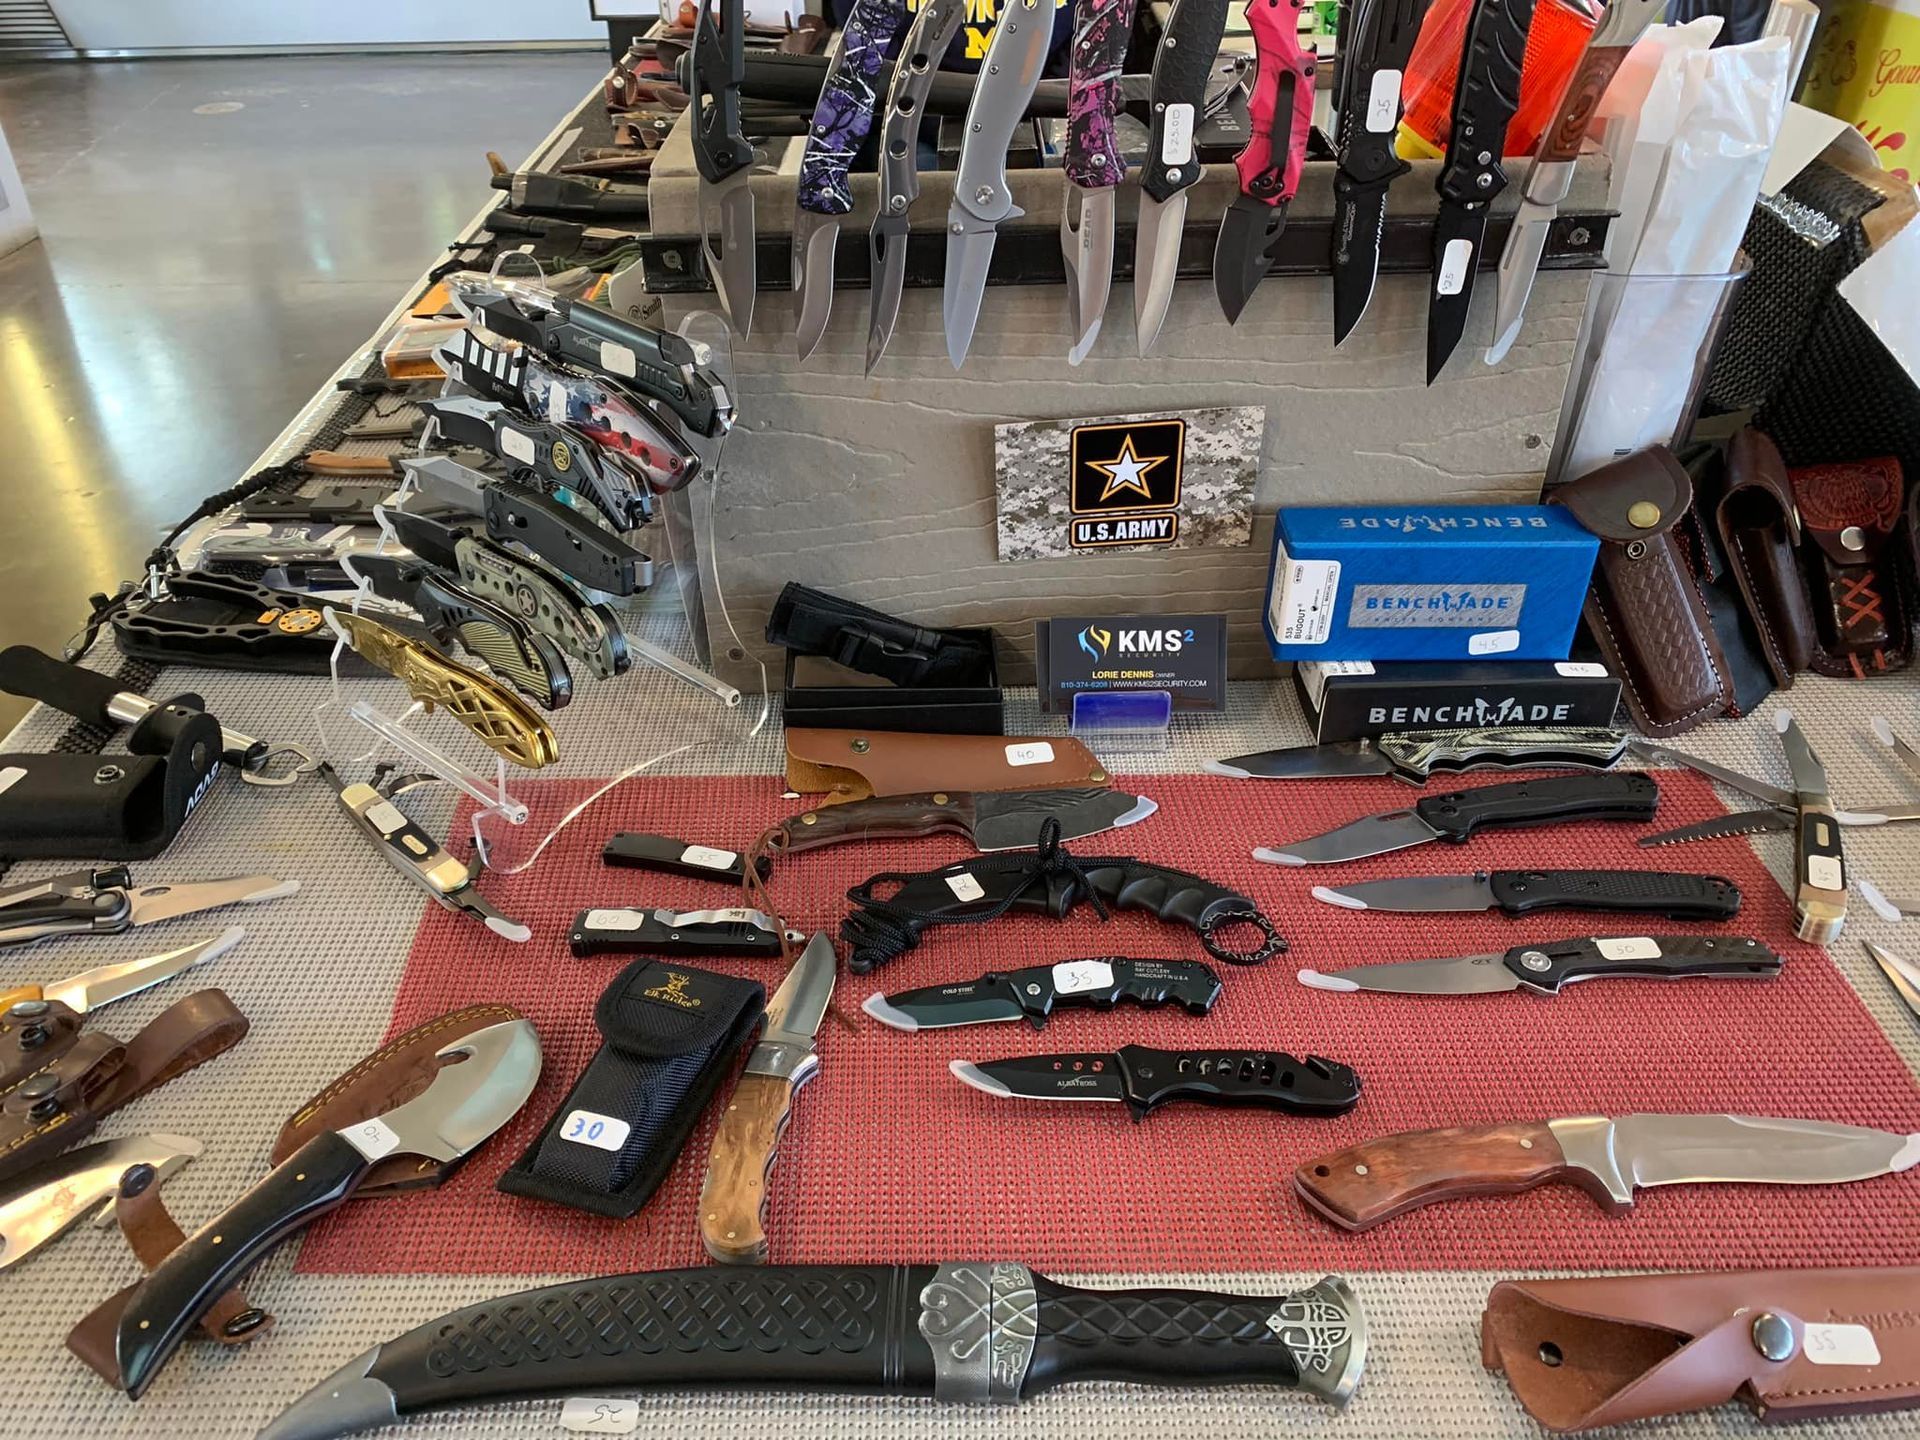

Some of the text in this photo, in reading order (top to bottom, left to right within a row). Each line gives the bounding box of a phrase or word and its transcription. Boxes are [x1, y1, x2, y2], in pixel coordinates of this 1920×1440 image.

[1376, 99, 1391, 118] 25
[1293, 608, 1306, 639] BUGOUT
[1091, 671, 1119, 680] LORIE
[1120, 670, 1154, 679] DENNIS
[1016, 750, 1035, 760] 40
[1615, 945, 1635, 955] 50
[1067, 970, 1093, 988] 35
[569, 1117, 606, 1141] 30
[1811, 1328, 1837, 1351] 35
